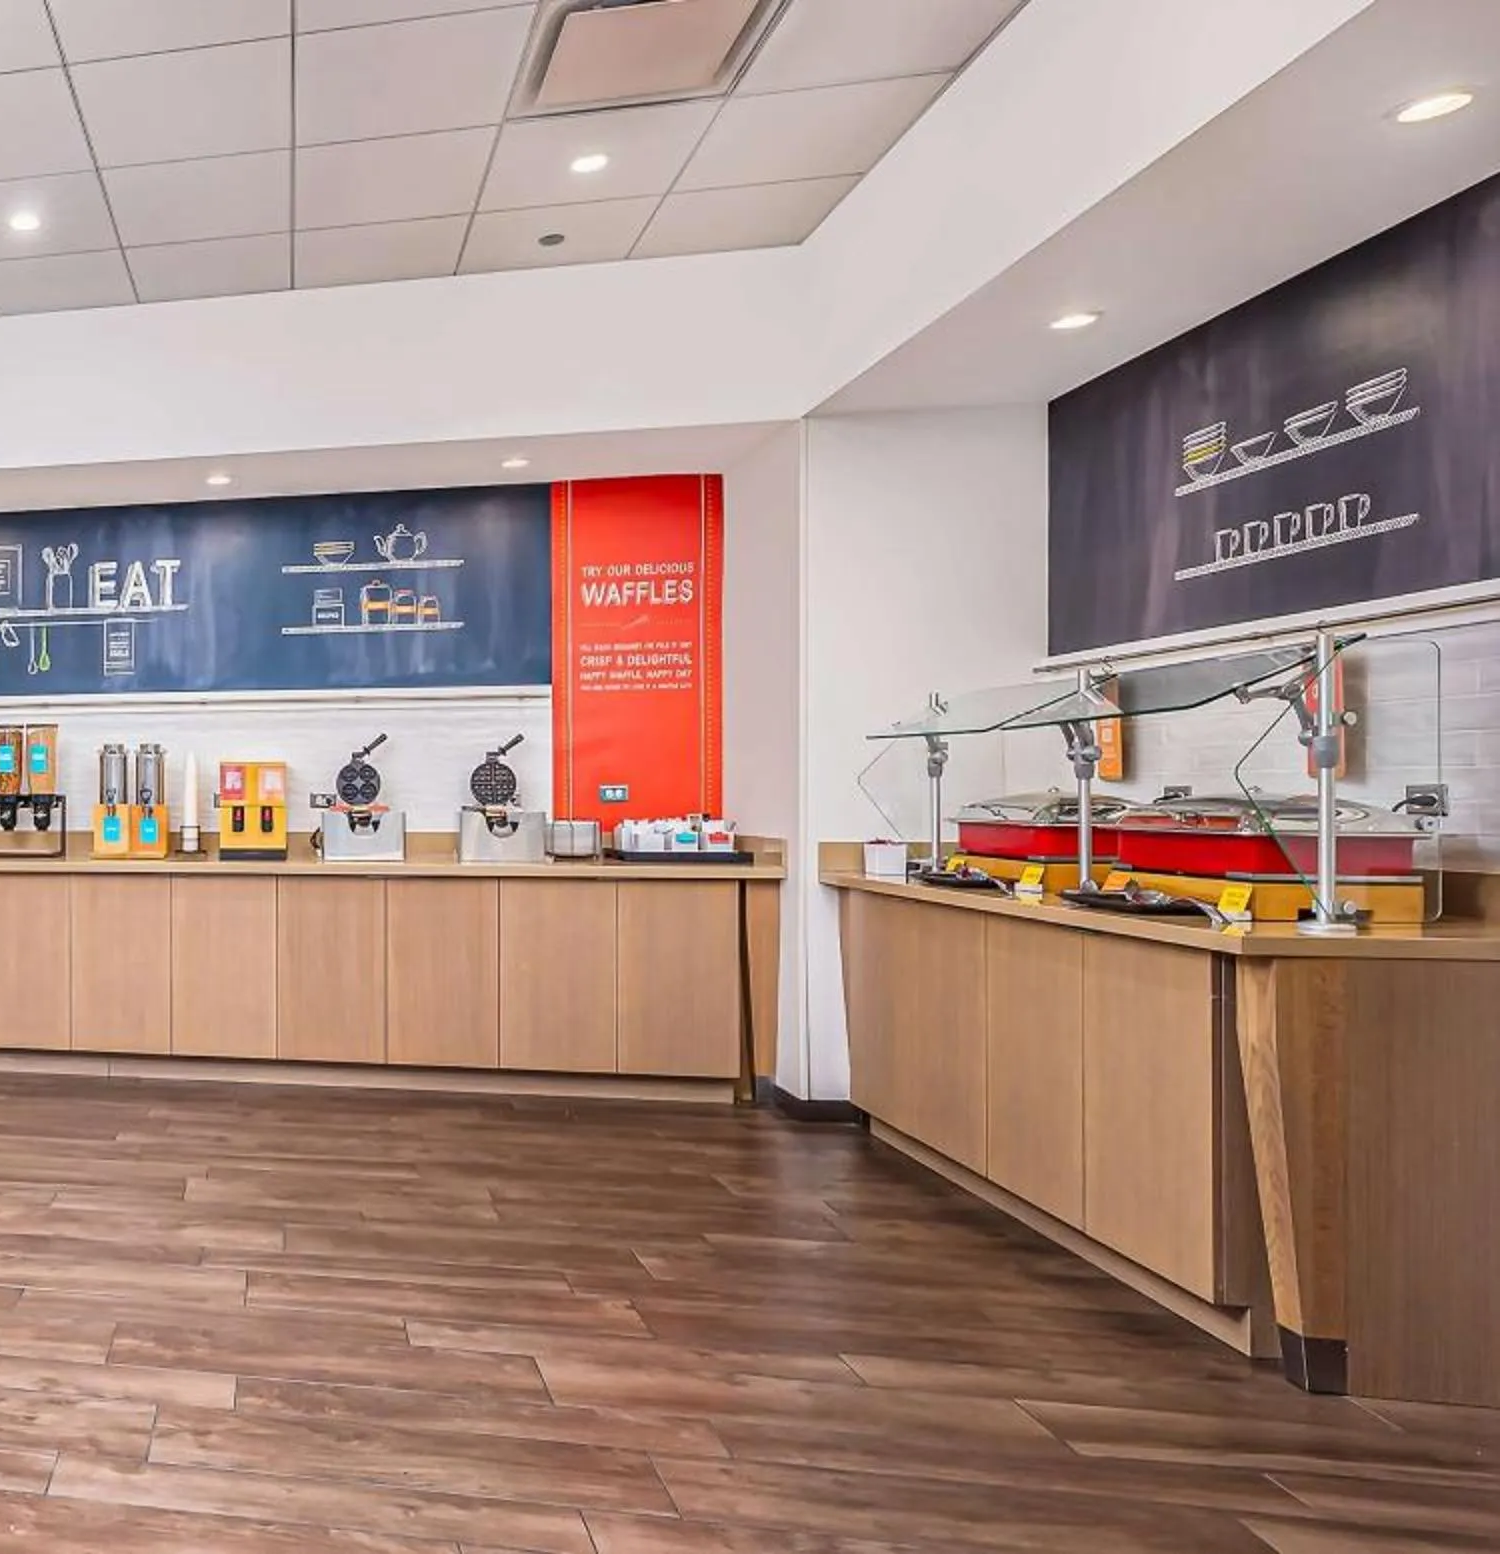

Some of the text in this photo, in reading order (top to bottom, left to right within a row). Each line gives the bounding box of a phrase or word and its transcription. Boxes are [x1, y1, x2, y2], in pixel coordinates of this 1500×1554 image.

[581, 561, 694, 578] TRY OUR DELICIOUS
[88, 559, 181, 609] EAT
[581, 579, 694, 608] WAFFLES
[580, 654, 612, 667] CRISP
